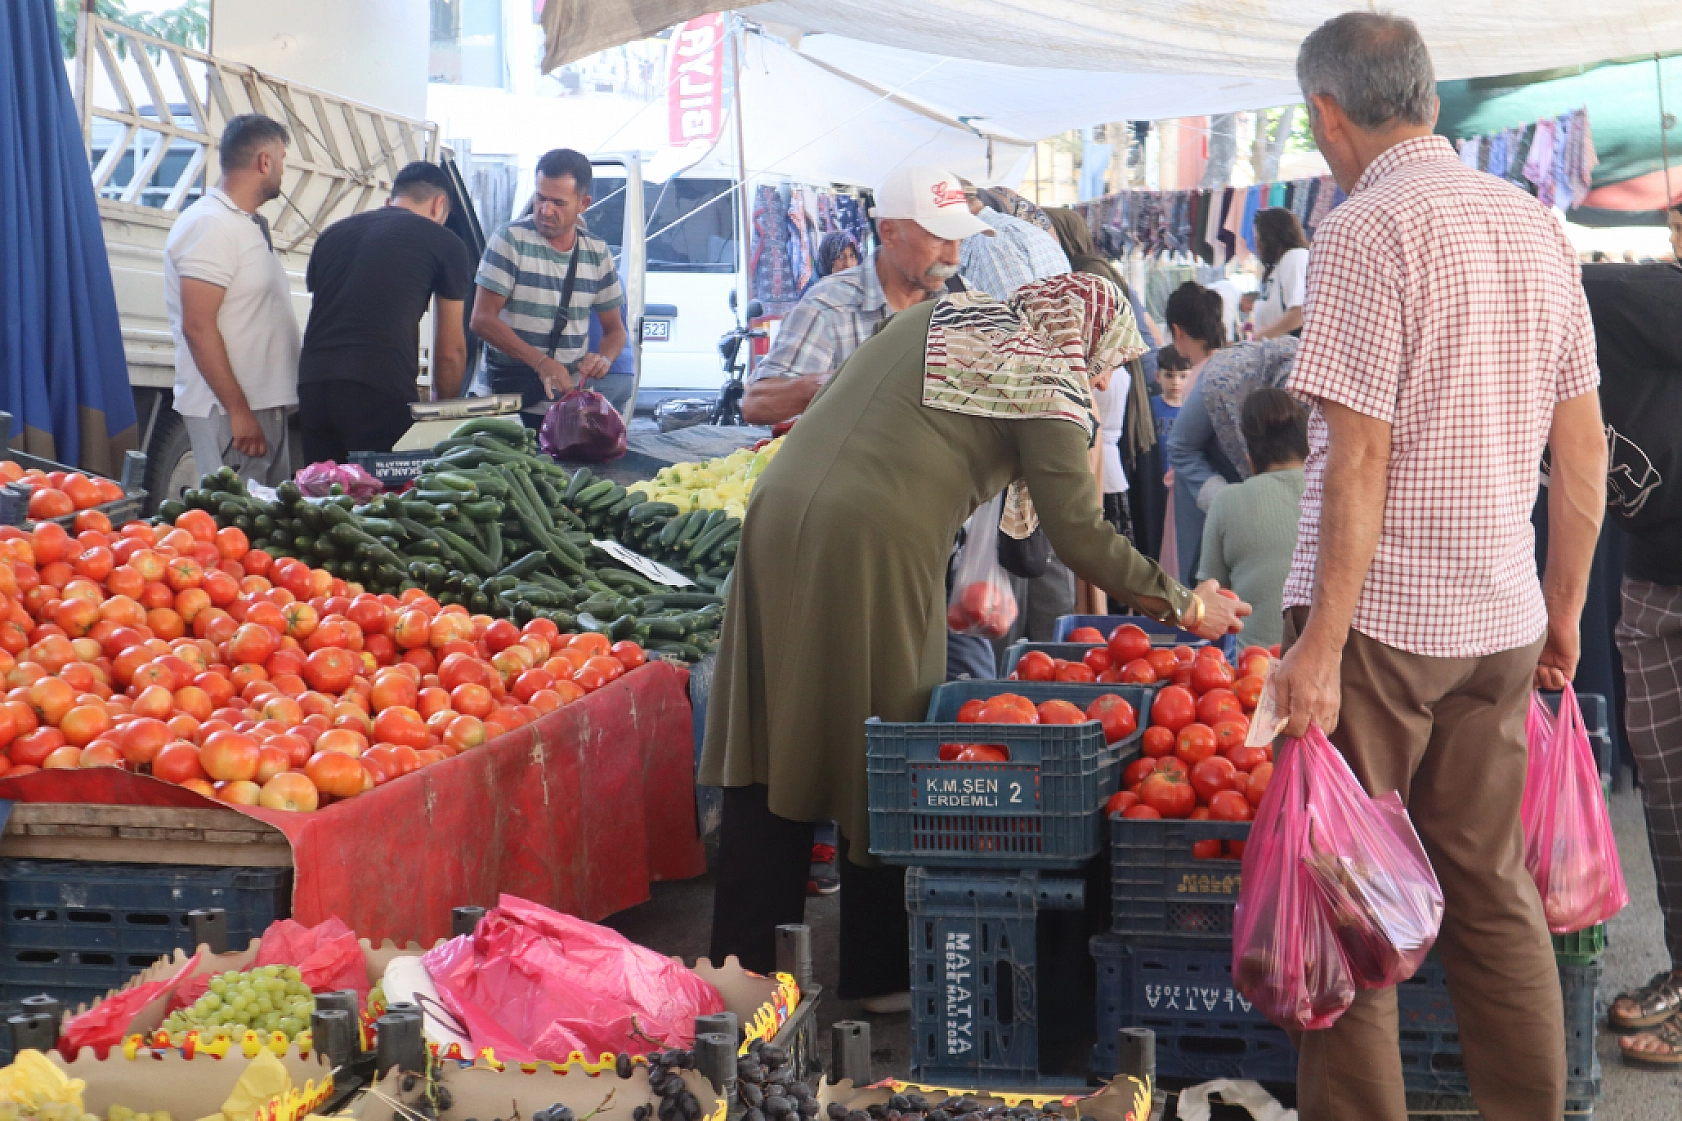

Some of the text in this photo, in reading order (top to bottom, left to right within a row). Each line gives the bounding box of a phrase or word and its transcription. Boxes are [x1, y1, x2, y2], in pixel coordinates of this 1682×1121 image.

[1009, 782, 1023, 803] 2
[955, 932, 972, 1055] MALATYA
[1146, 992, 1253, 1013] ALATYA
